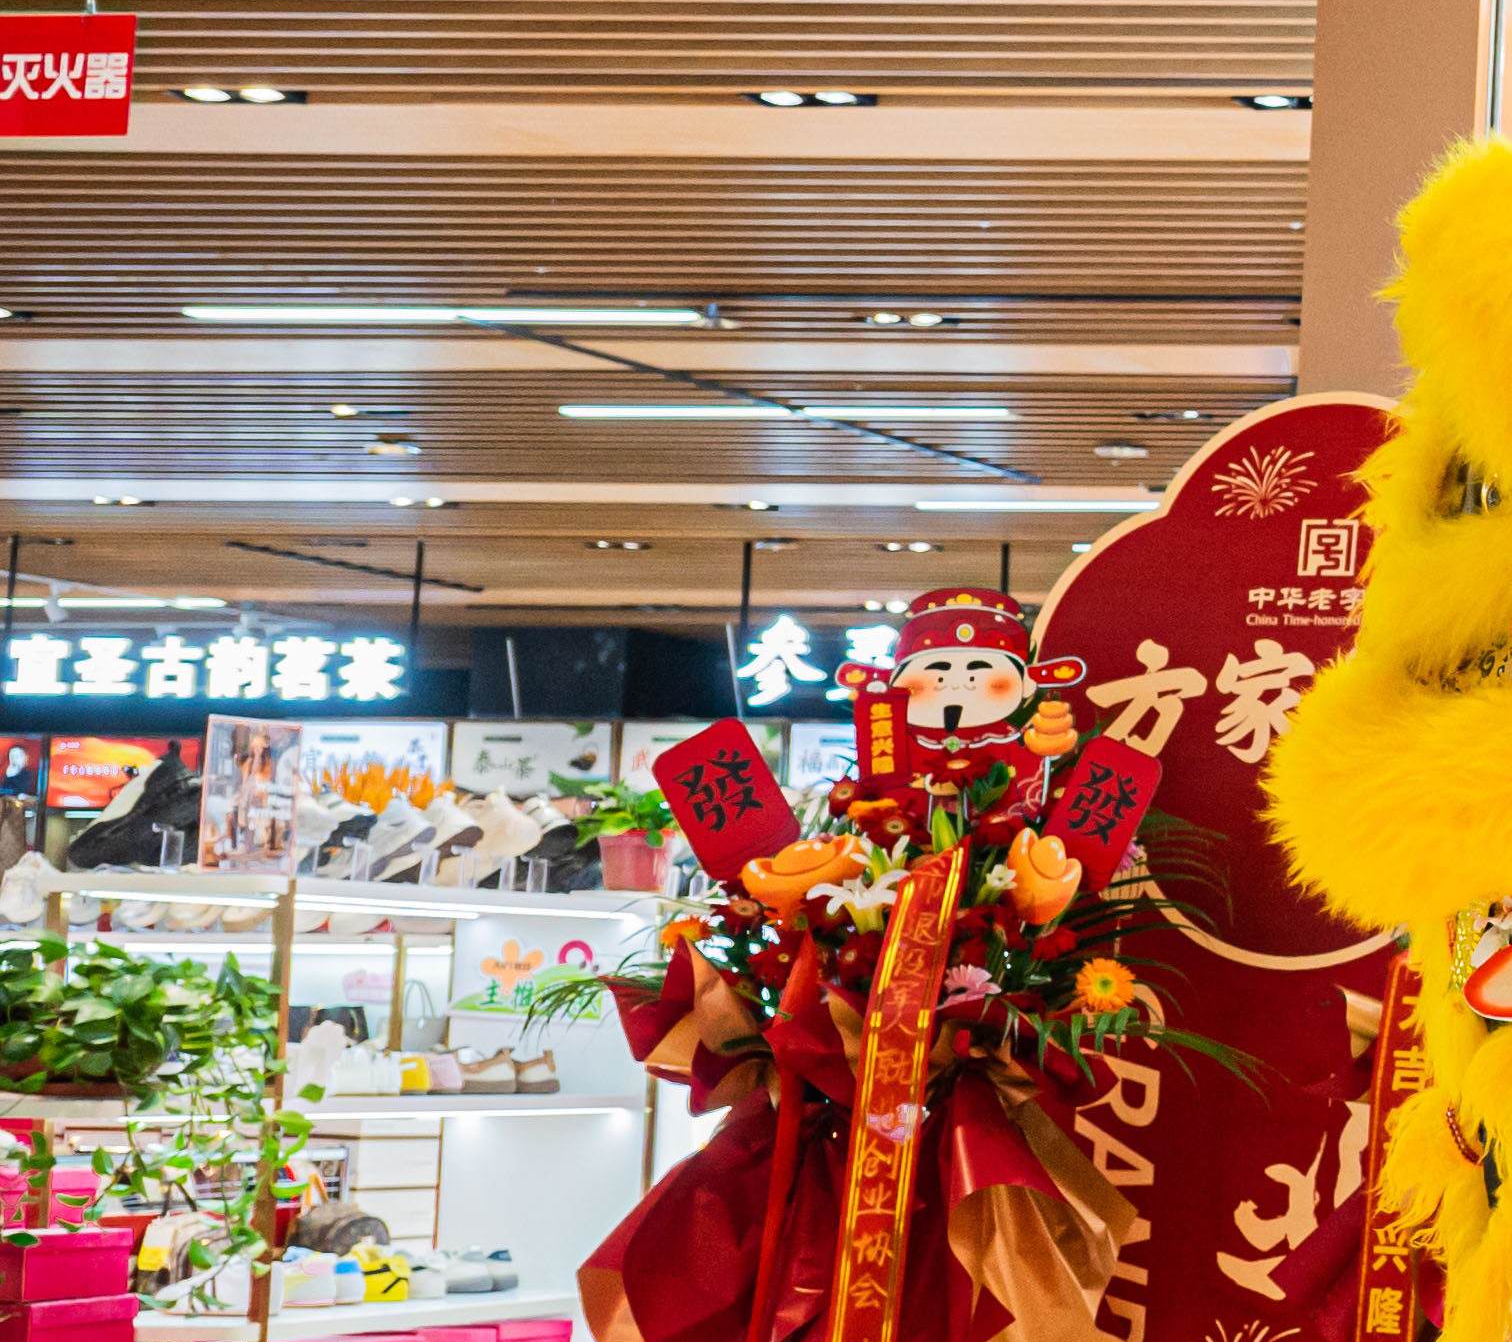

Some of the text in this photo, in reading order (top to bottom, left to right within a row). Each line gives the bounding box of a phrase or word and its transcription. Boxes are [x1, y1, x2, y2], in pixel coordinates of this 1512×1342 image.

[0, 52, 129, 102] 灭火器
[1246, 614, 1278, 628] China
[4, 634, 405, 701] 宜圣古韵茗茶
[868, 702, 897, 776] 生意兴隆
[672, 749, 766, 834] 發
[1066, 760, 1139, 848] 發
